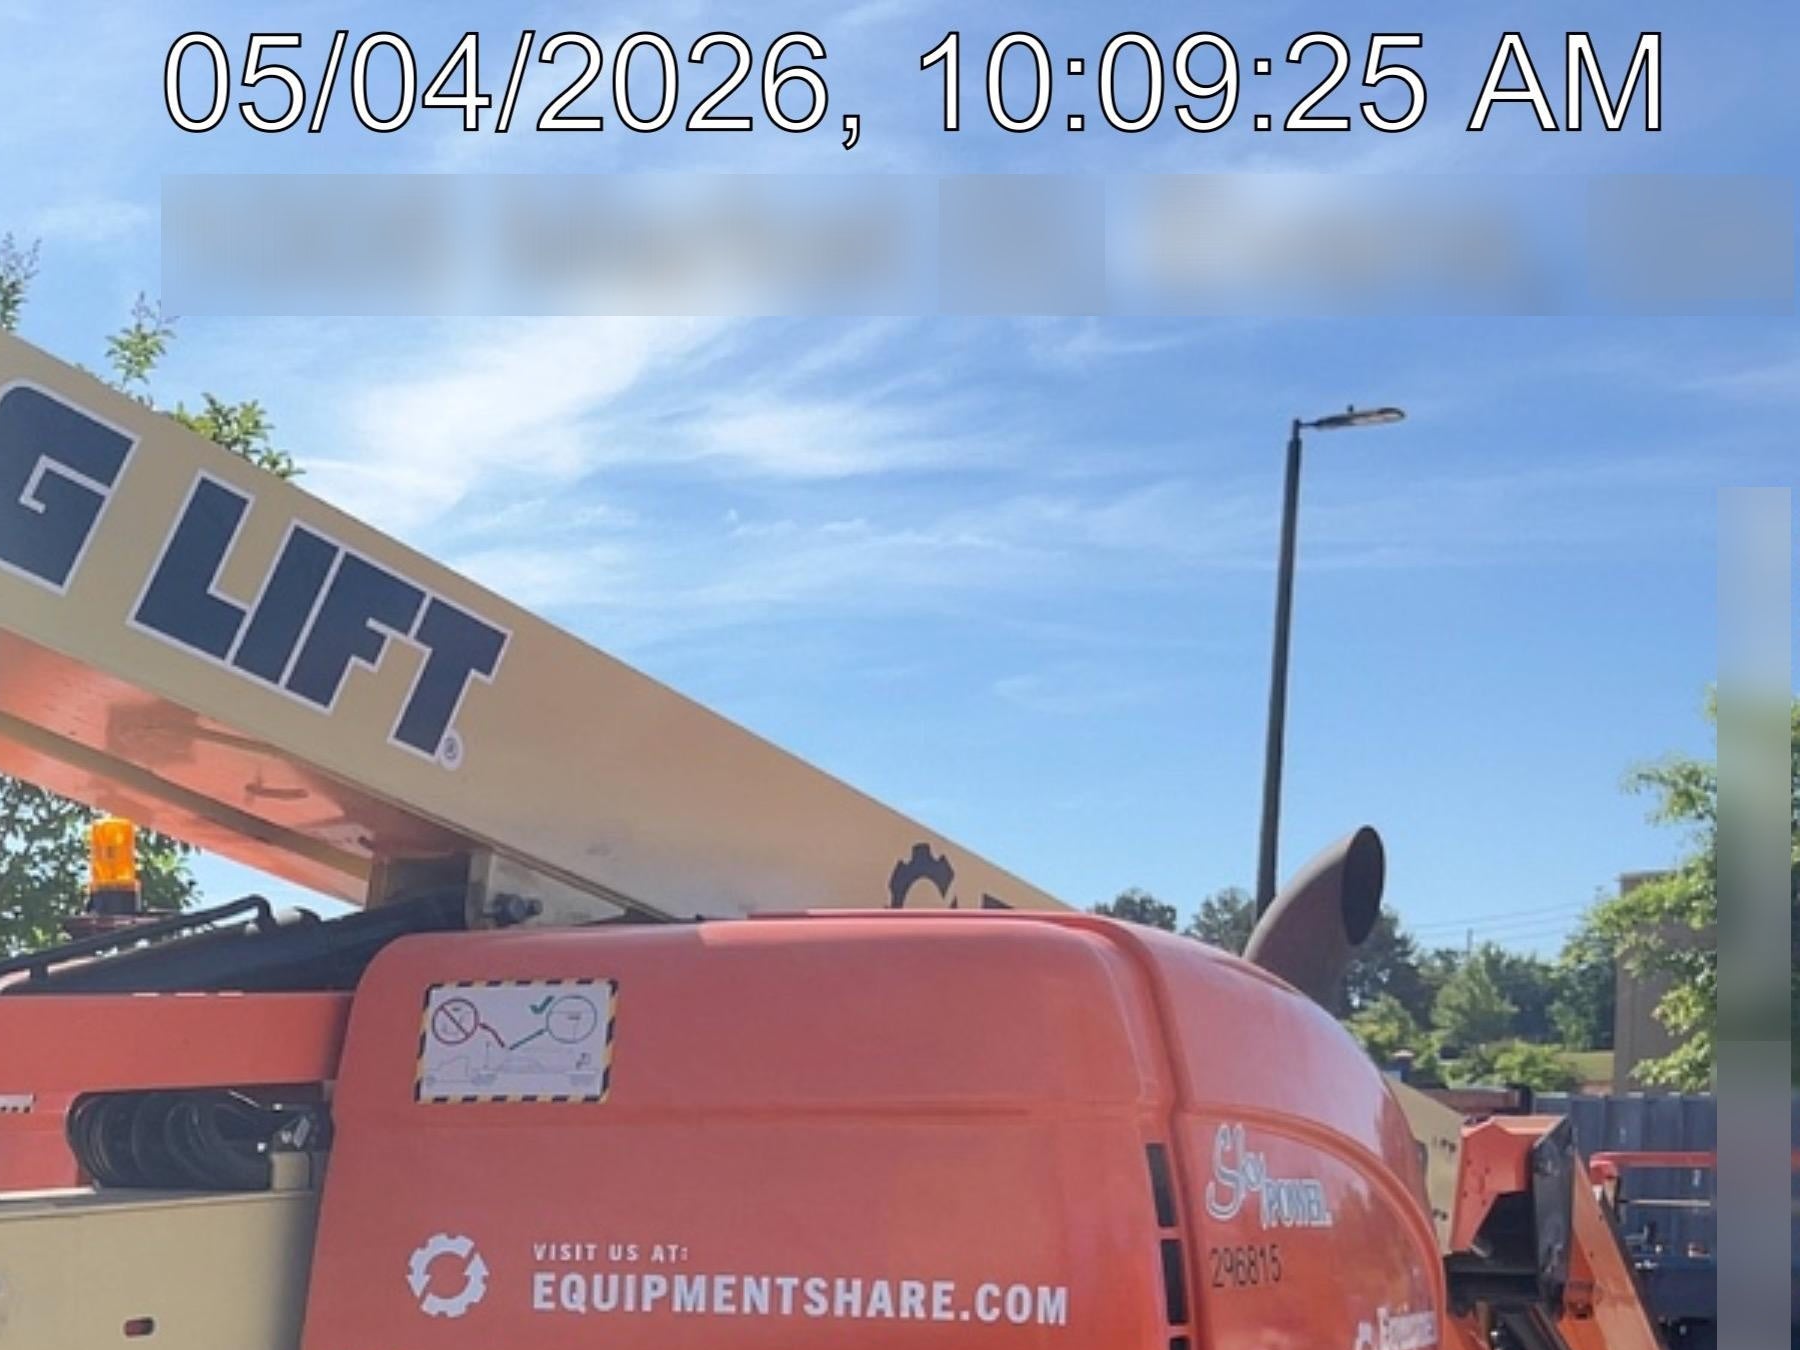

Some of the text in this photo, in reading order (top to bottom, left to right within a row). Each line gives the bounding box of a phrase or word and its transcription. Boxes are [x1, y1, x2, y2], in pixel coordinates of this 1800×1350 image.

[532, 1242, 689, 1265] VISIT US AT:
[1210, 1243, 1282, 1289] 296815
[532, 1271, 1068, 1327] EQUIPMENTSHARE.COM
